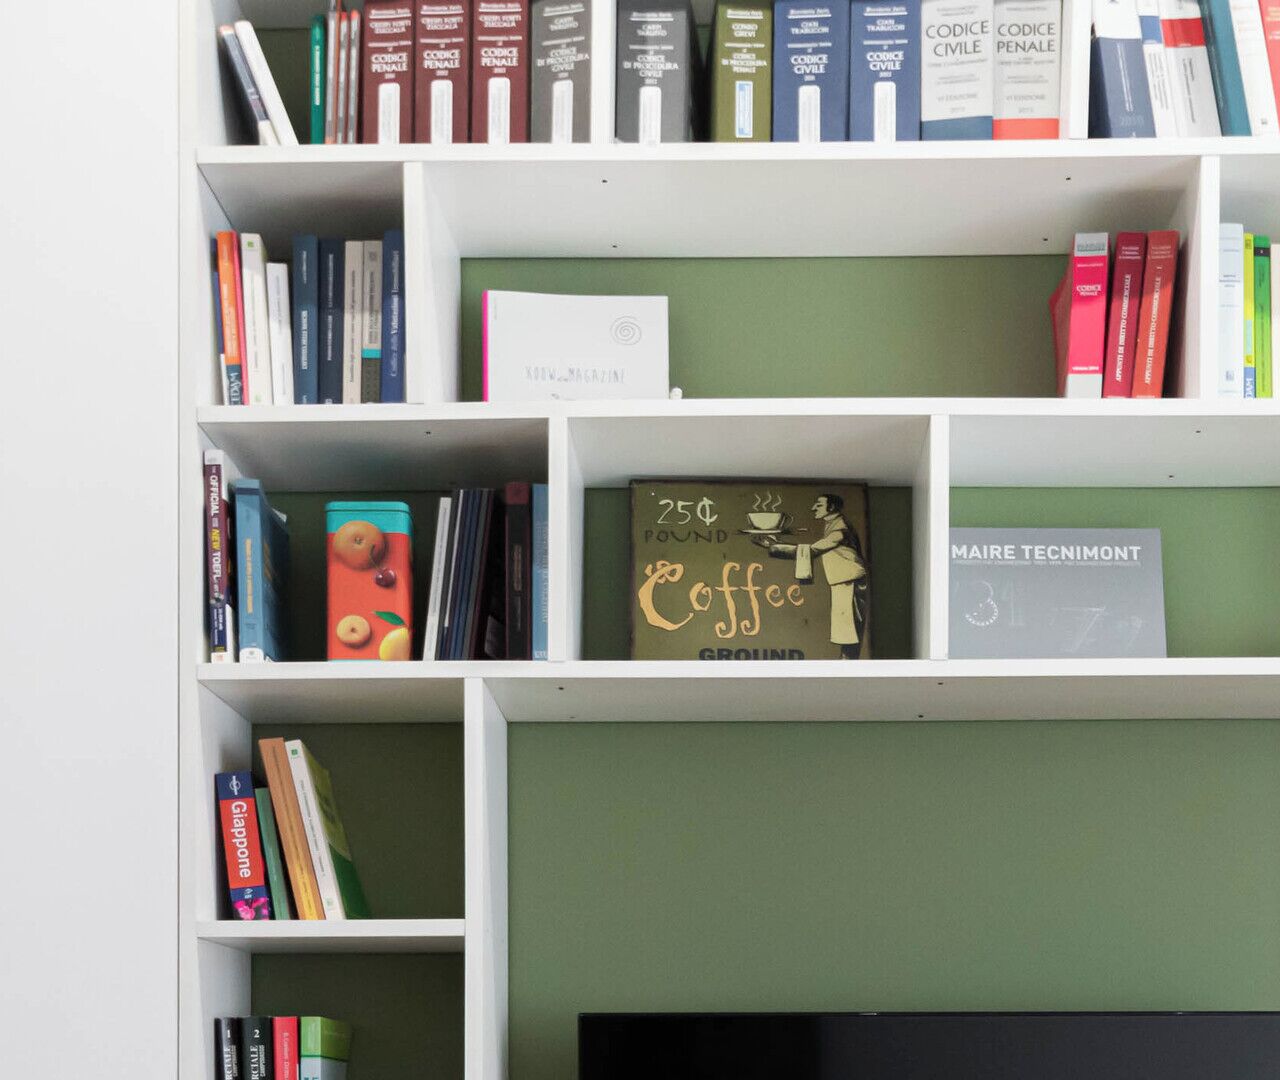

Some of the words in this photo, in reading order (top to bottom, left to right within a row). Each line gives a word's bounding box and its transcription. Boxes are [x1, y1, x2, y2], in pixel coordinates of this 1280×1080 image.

[926, 20, 990, 39] CODICE
[998, 22, 1056, 36] CODICE
[481, 47, 518, 57] CODICE
[934, 40, 982, 57] CIVILE
[997, 40, 1056, 54] PENALE
[371, 52, 408, 62] CODICE
[423, 49, 460, 60] CODICE
[481, 56, 518, 66] PENALE
[790, 54, 828, 65] CODICE
[866, 51, 904, 62] CODICE
[371, 62, 408, 72] PENALE
[423, 59, 460, 70] PENALE
[793, 64, 826, 74] CIVILE
[869, 60, 902, 70] CIVILE
[210, 475, 220, 516] OFFICIAL
[657, 497, 718, 526] 25¢
[211, 528, 220, 550] NEW
[644, 529, 729, 544] POUND
[952, 545, 1016, 560] MAIRE
[1021, 546, 1141, 561] TECNIMONT
[212, 551, 222, 579] TOEFL
[638, 560, 805, 639] Coffee
[699, 648, 805, 660] GROUND
[230, 801, 252, 878] Giappone
[254, 1030, 260, 1038] 2
